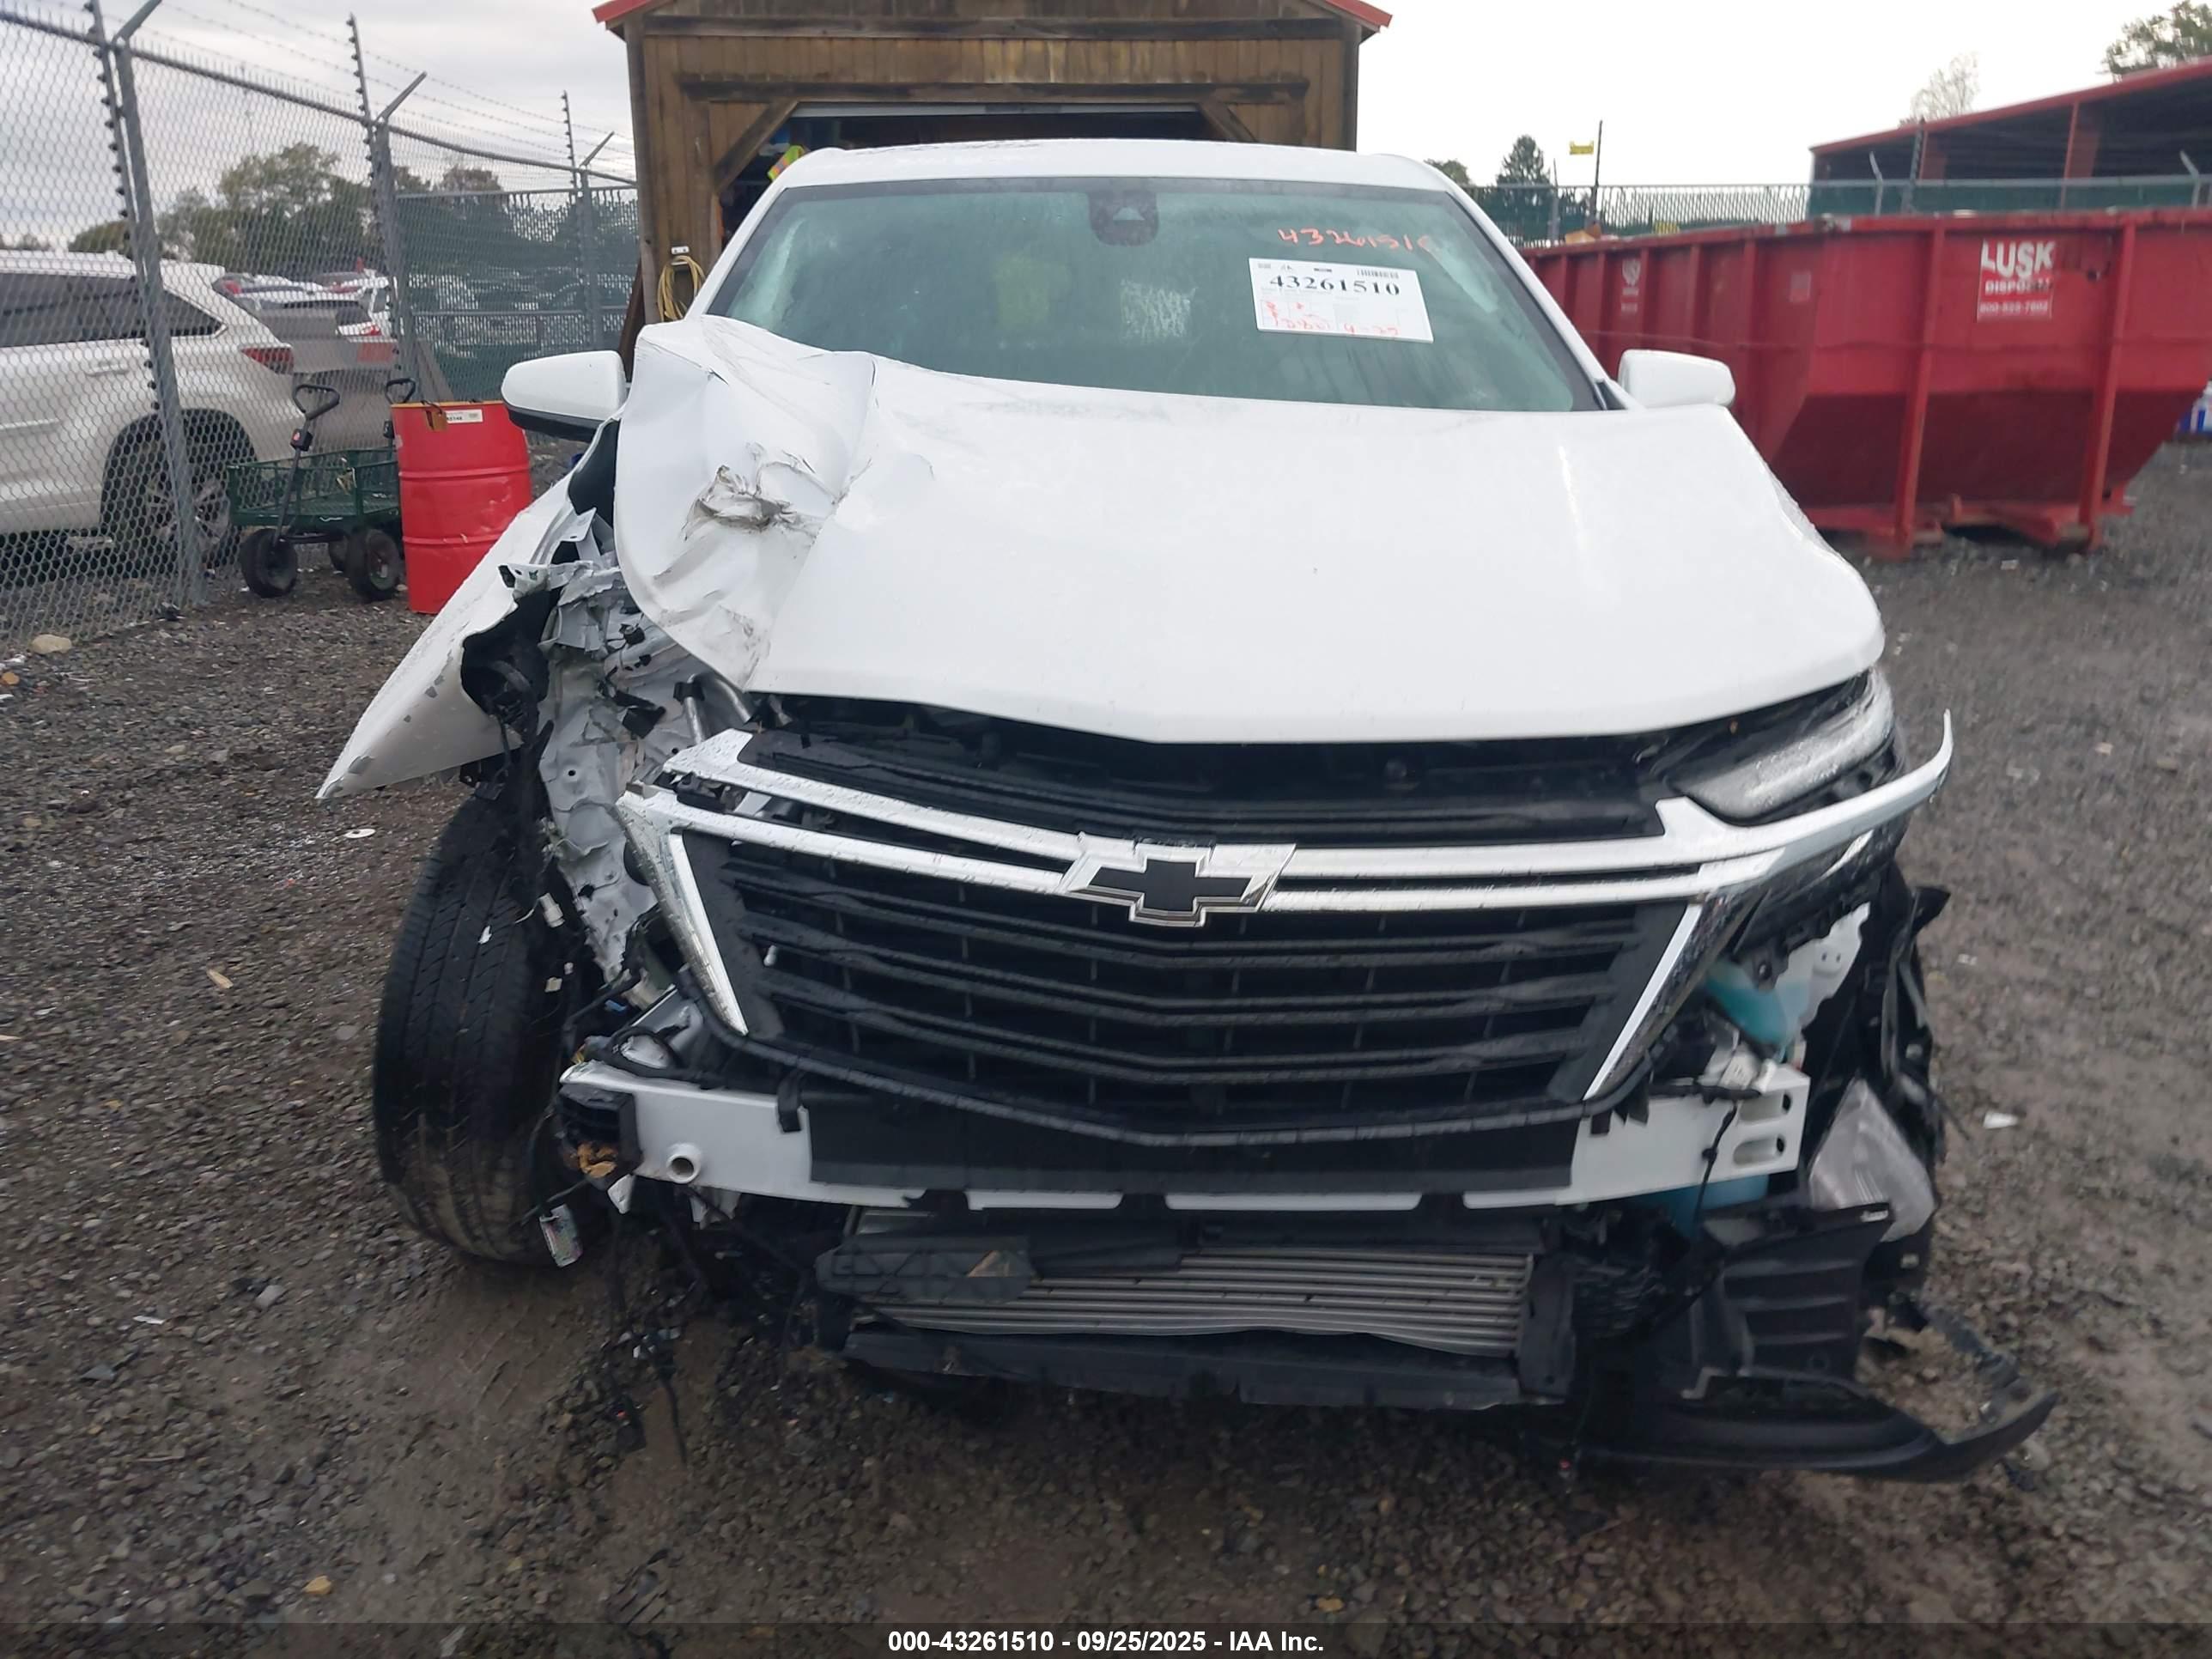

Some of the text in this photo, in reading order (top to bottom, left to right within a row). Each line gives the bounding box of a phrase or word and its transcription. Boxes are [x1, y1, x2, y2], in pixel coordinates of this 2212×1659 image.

[1980, 240, 2056, 278] LUSK
[1270, 274, 1400, 296] 43261510
[1985, 278, 2052, 295] DISPO
